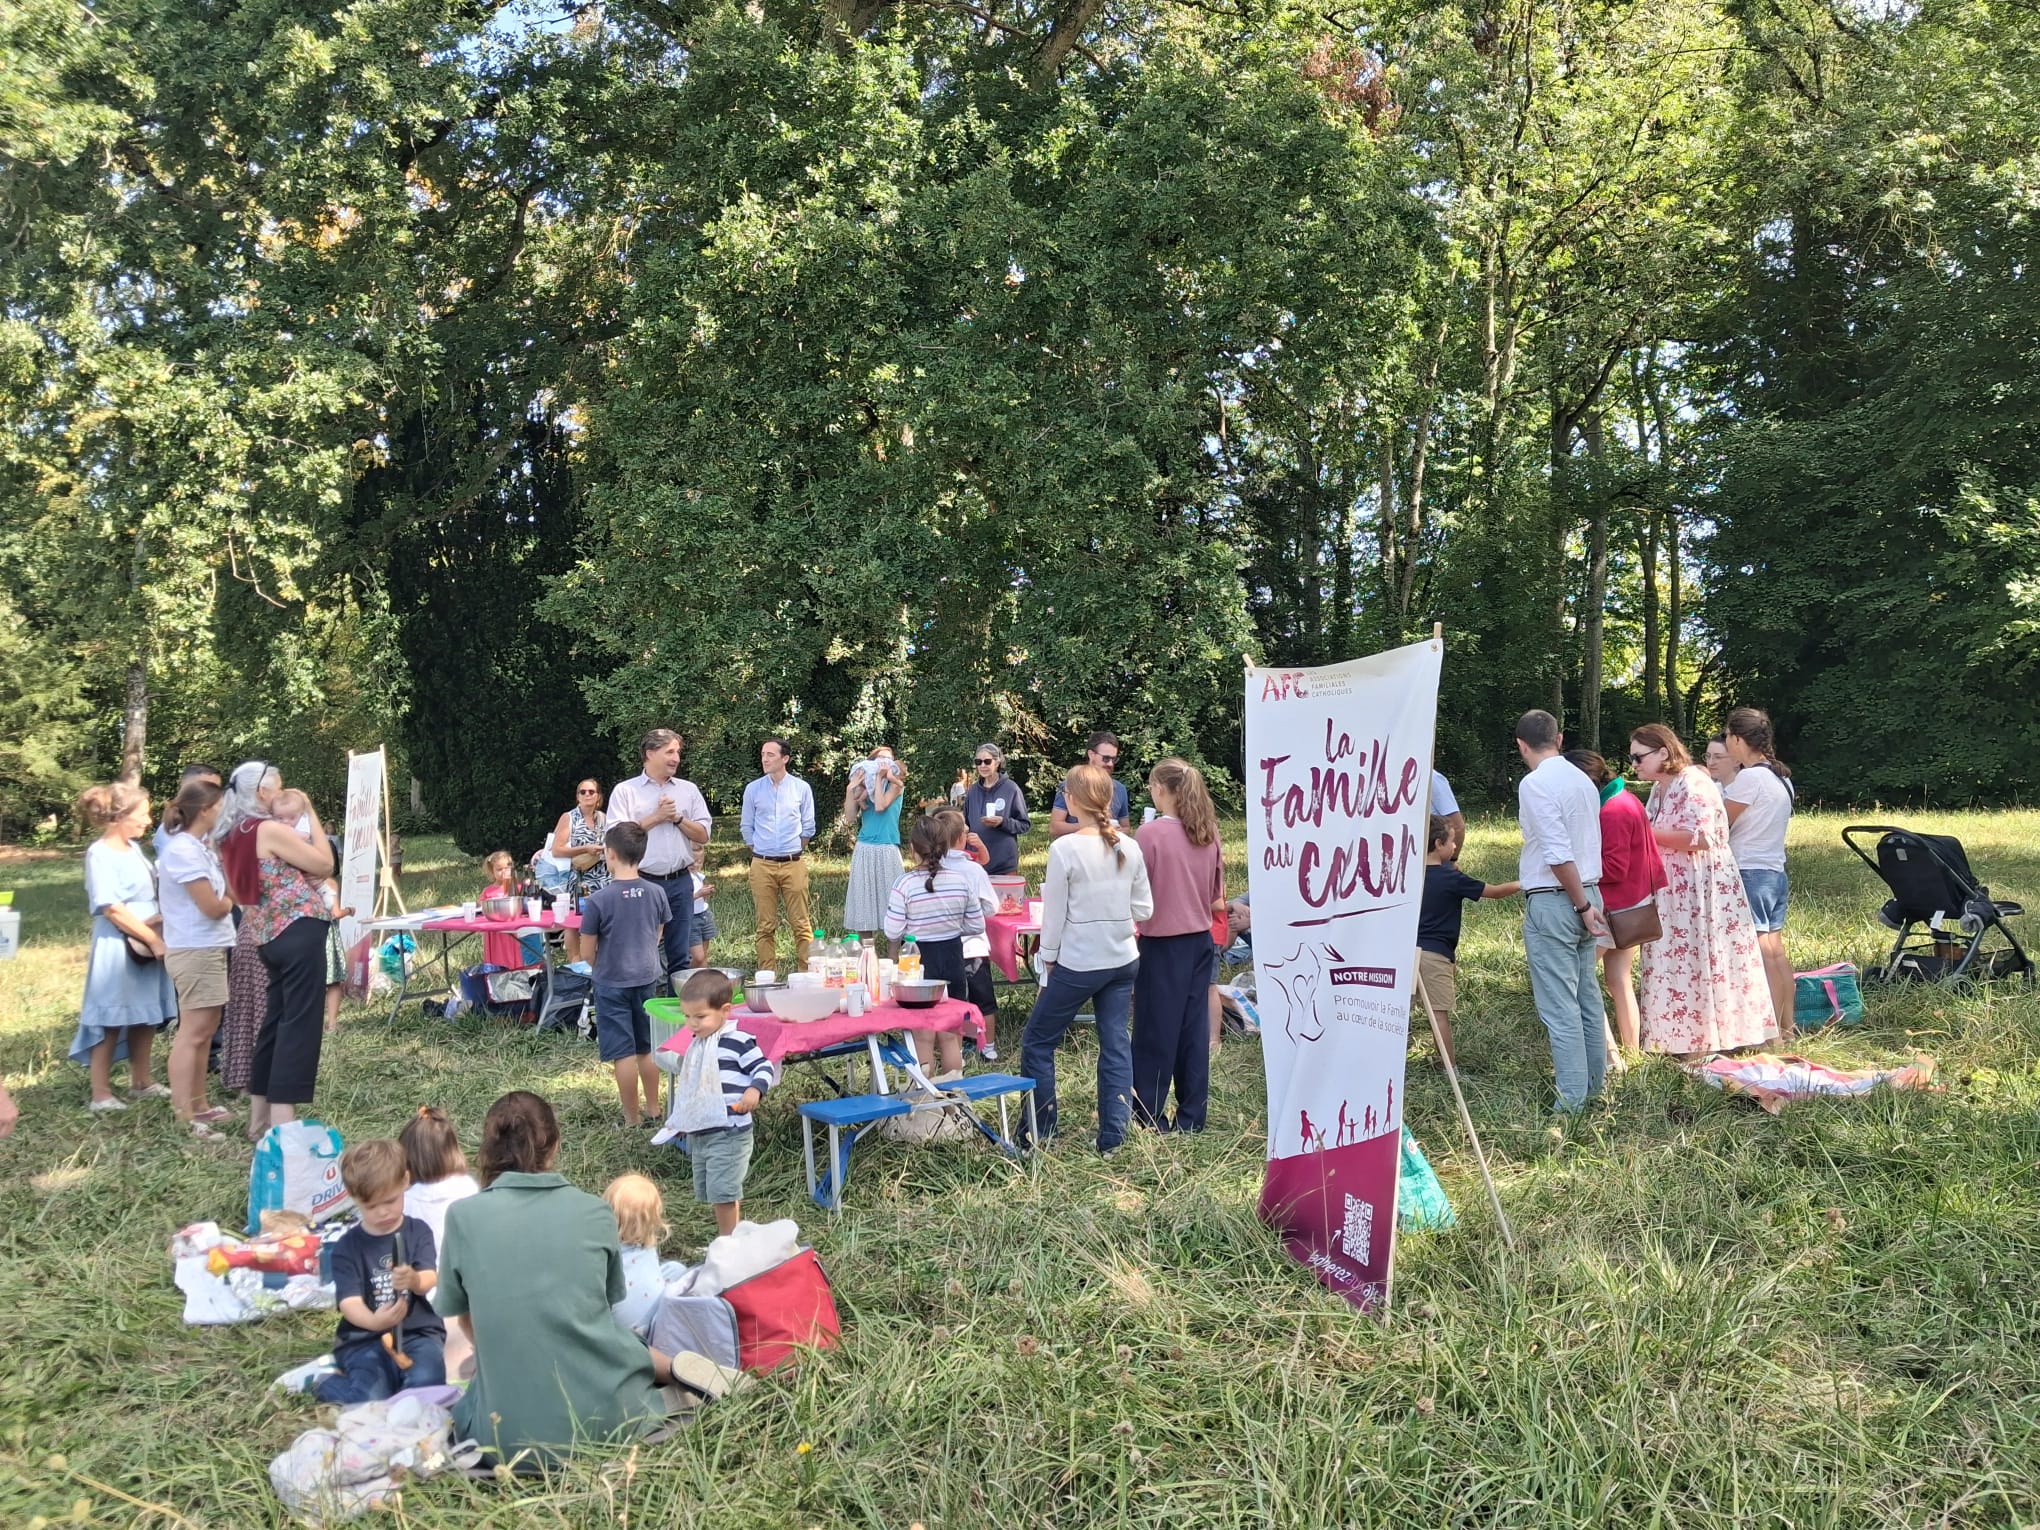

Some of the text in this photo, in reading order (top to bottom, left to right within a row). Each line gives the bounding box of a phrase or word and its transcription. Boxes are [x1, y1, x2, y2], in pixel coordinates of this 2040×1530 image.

[1261, 672, 1308, 702] AFC
[1311, 680, 1346, 690] FAMILIALES
[1311, 688, 1353, 698] CATHOLIQUES
[1260, 733, 1421, 841] Famille
[1264, 842, 1294, 871] au
[1333, 971, 1393, 985] NOTRE MISSION
[1334, 994, 1379, 1013] Promouvoir
[1380, 1001, 1387, 1014] la
[1336, 1011, 1350, 1021] au
[1368, 1015, 1377, 1028] de
[1377, 1017, 1384, 1030] la
[326, 1166, 336, 1180] U
[312, 1182, 344, 1206] DRIV
